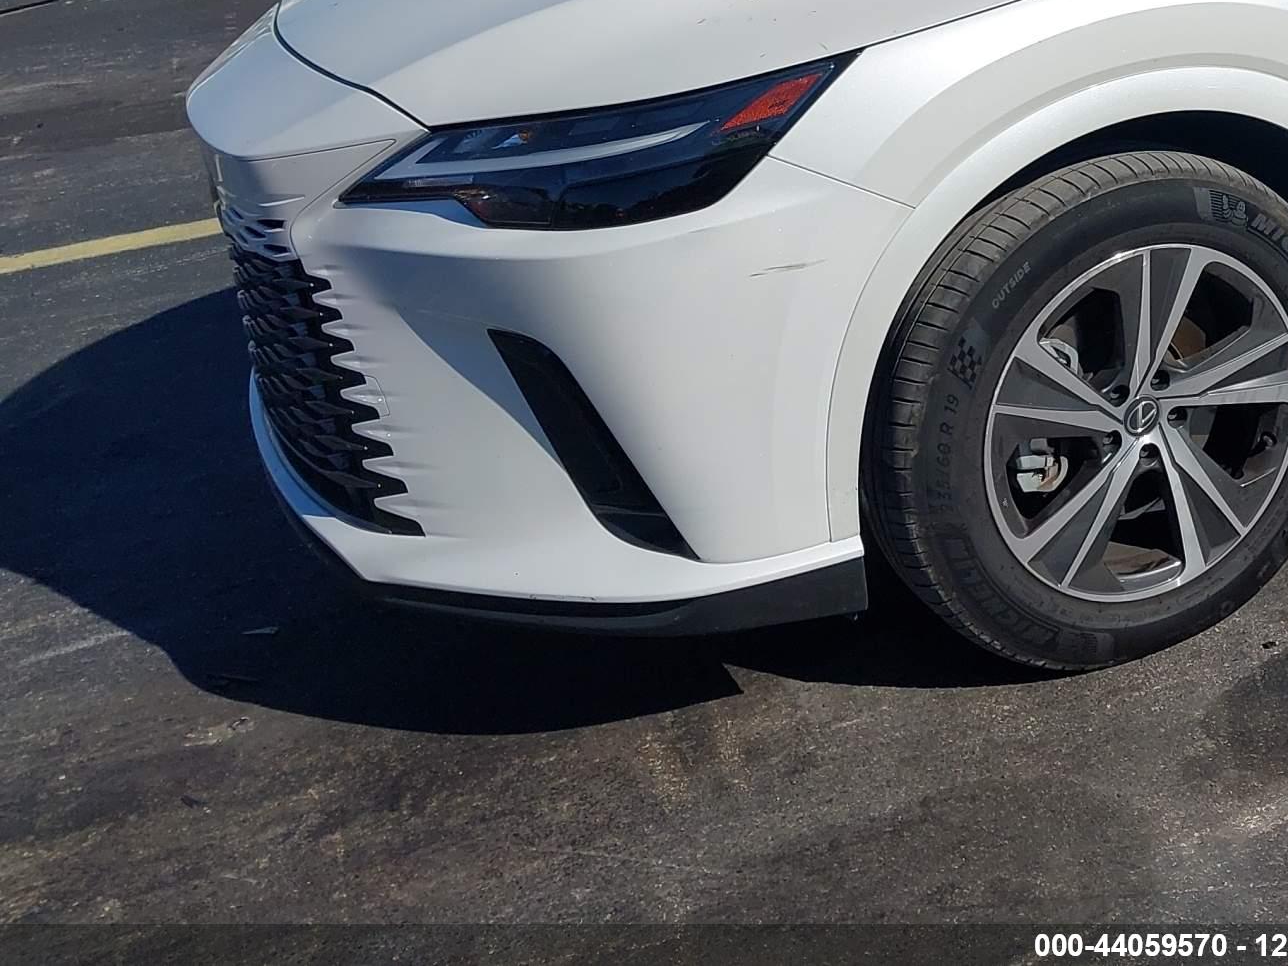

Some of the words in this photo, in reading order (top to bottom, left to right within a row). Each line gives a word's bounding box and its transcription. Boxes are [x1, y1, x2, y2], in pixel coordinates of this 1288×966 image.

[991, 261, 1032, 309] OUTSIDE
[944, 394, 960, 416] 19
[940, 422, 954, 436] R
